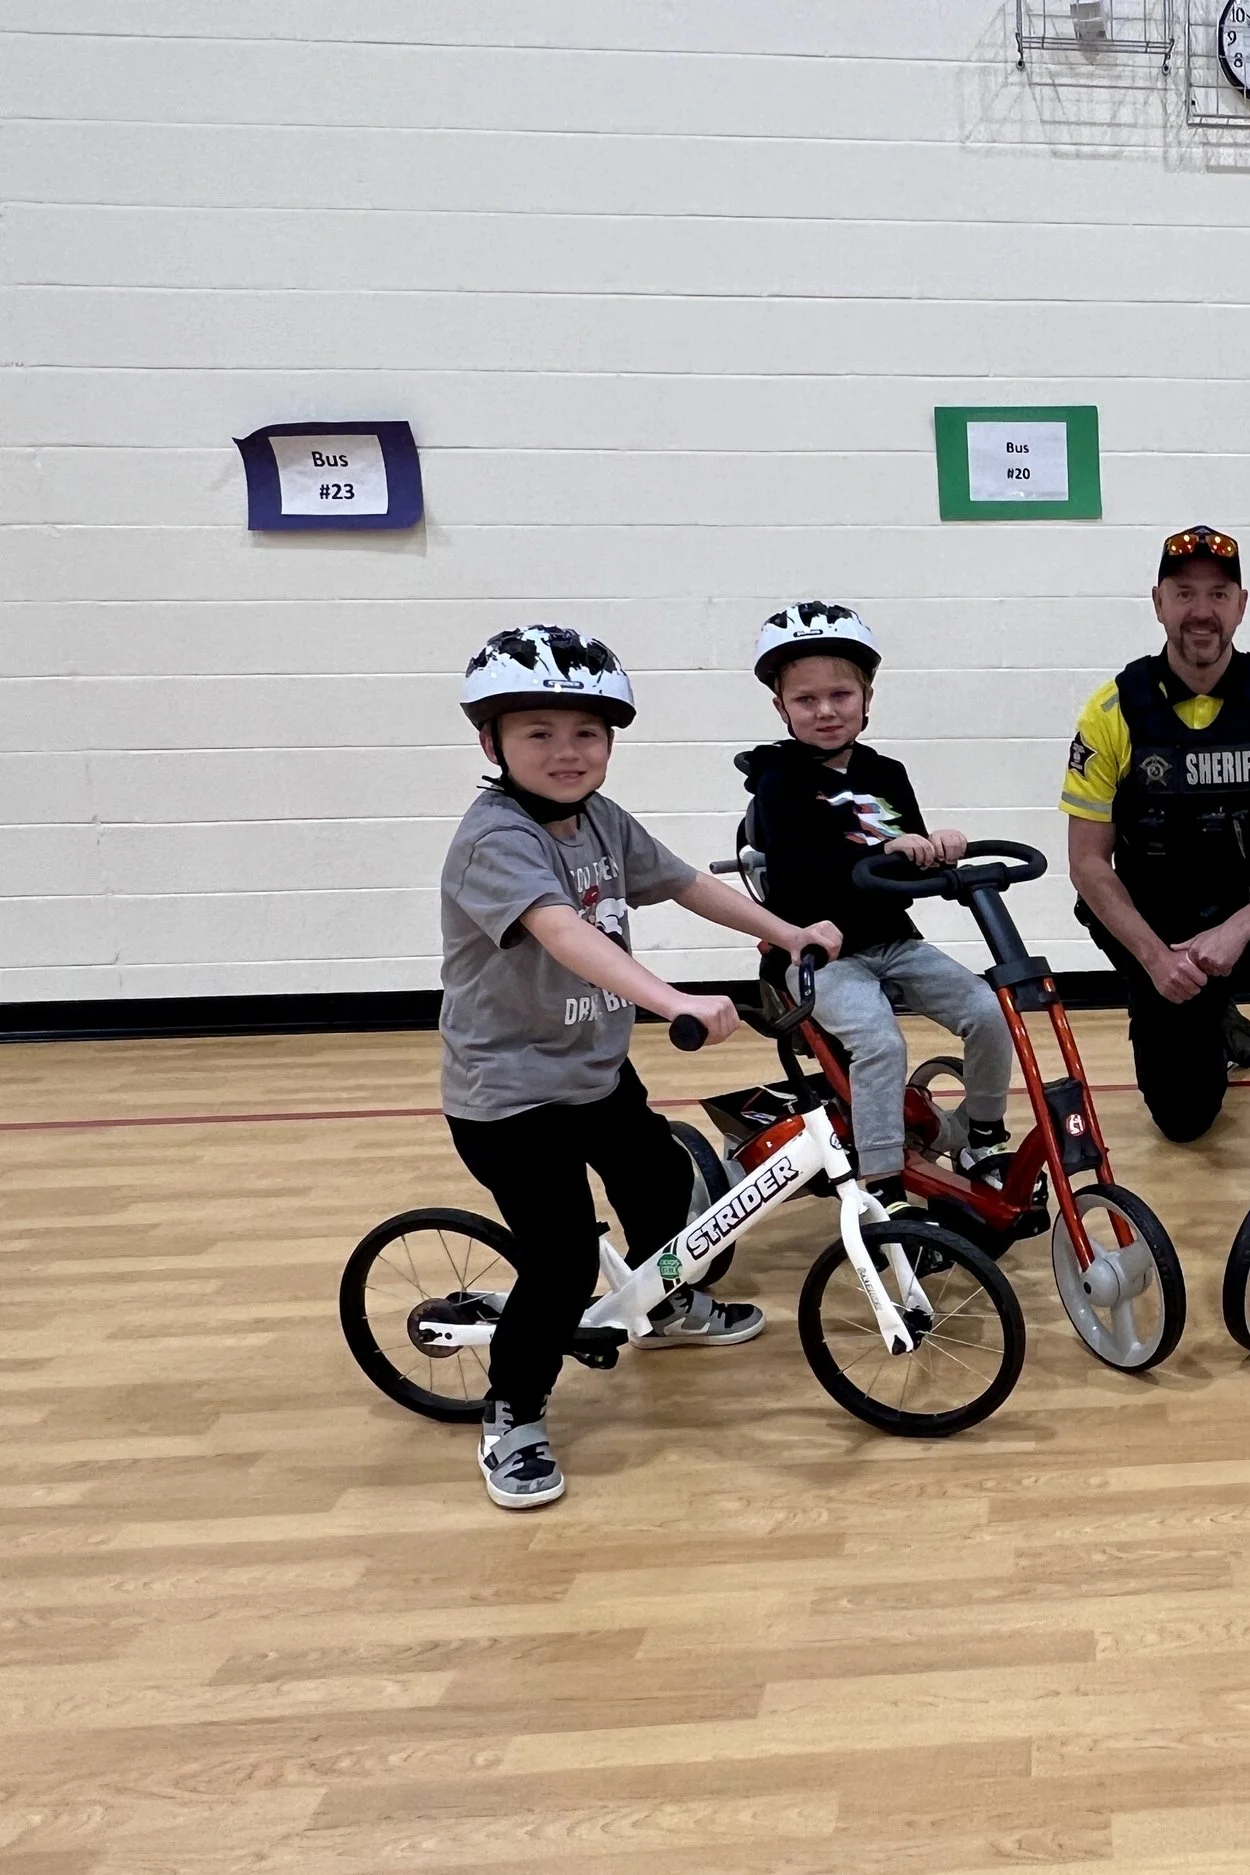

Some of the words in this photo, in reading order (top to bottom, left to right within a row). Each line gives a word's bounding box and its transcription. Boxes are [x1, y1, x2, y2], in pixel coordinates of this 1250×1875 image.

[1231, 6, 1246, 22] 10
[1227, 30, 1237, 46] 9
[1233, 53, 1243, 68] 8
[1006, 442, 1030, 454] Bus
[311, 451, 349, 467] Bus
[1007, 468, 1031, 480] #20
[319, 484, 355, 500] #23
[686, 1156, 799, 1260] STRIDER
